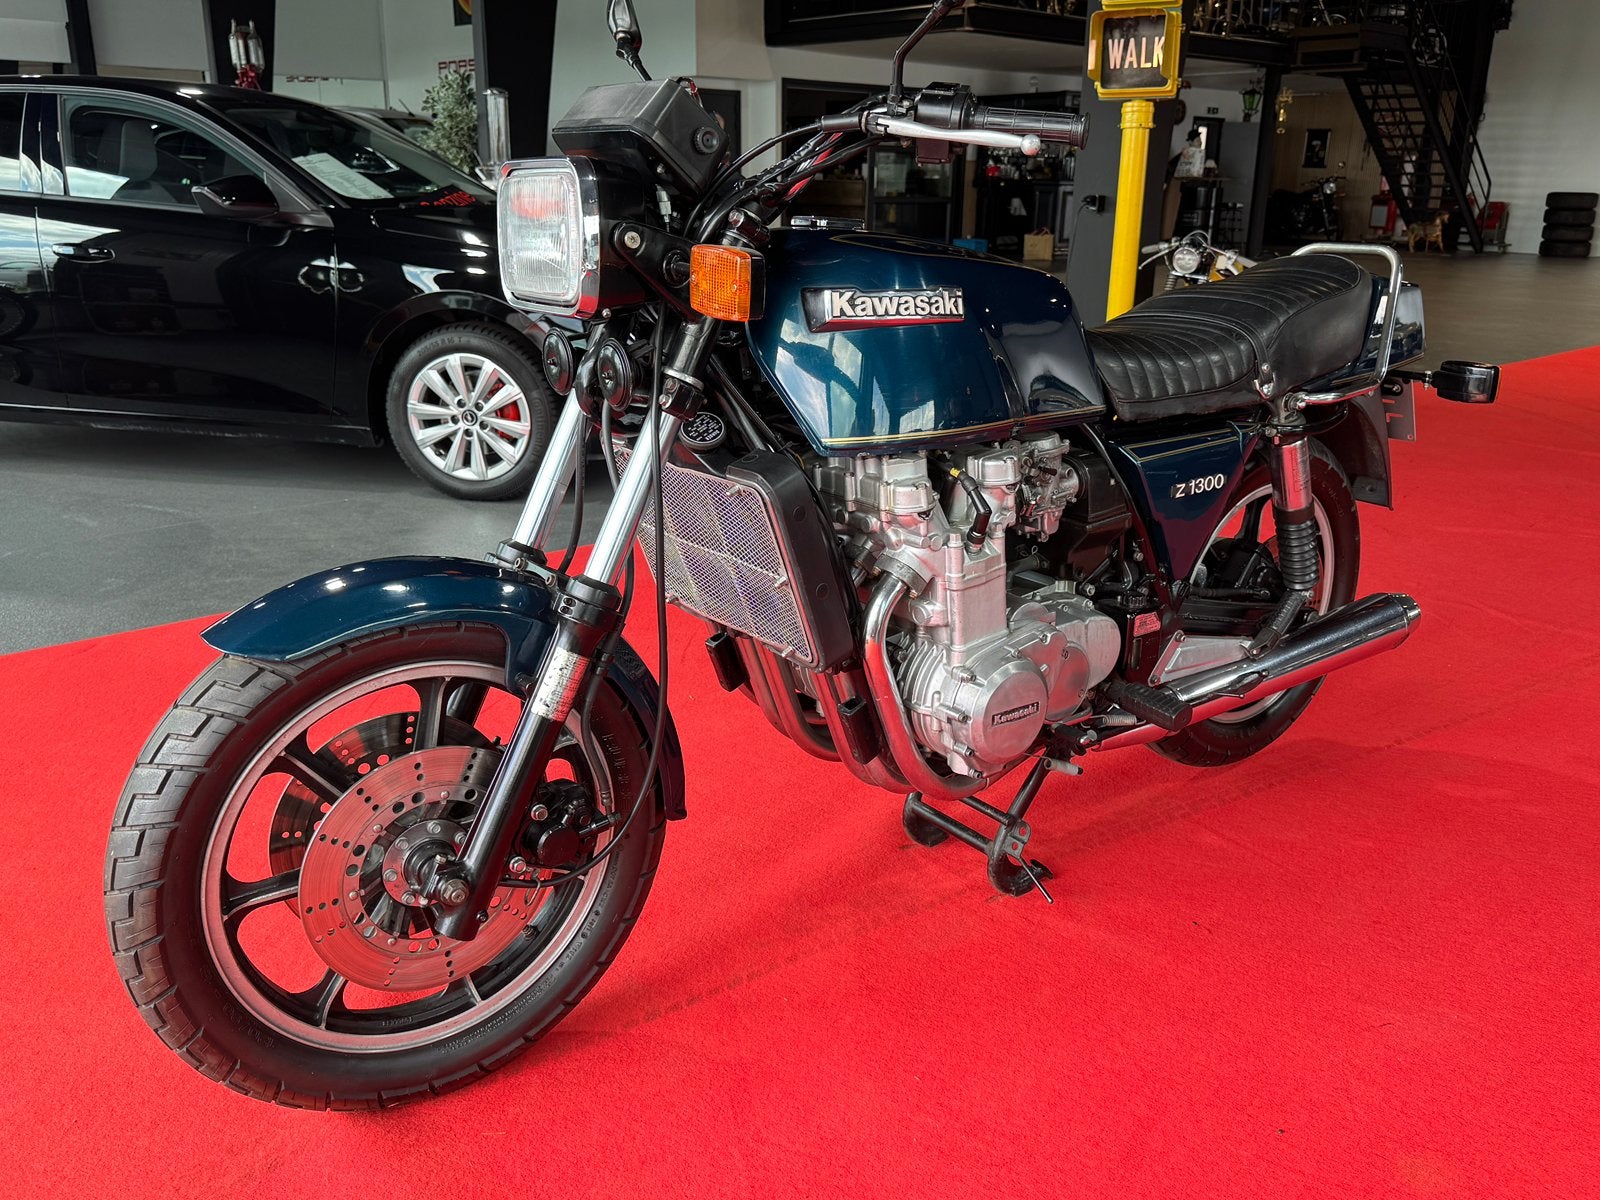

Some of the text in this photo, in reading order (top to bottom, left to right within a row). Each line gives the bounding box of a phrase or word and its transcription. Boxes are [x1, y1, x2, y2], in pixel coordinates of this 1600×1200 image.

[1108, 36, 1165, 69] WALK
[831, 290, 964, 317] Kawasaki
[1175, 473, 1224, 499] Z 1300
[993, 703, 1038, 725] Kawasaki
